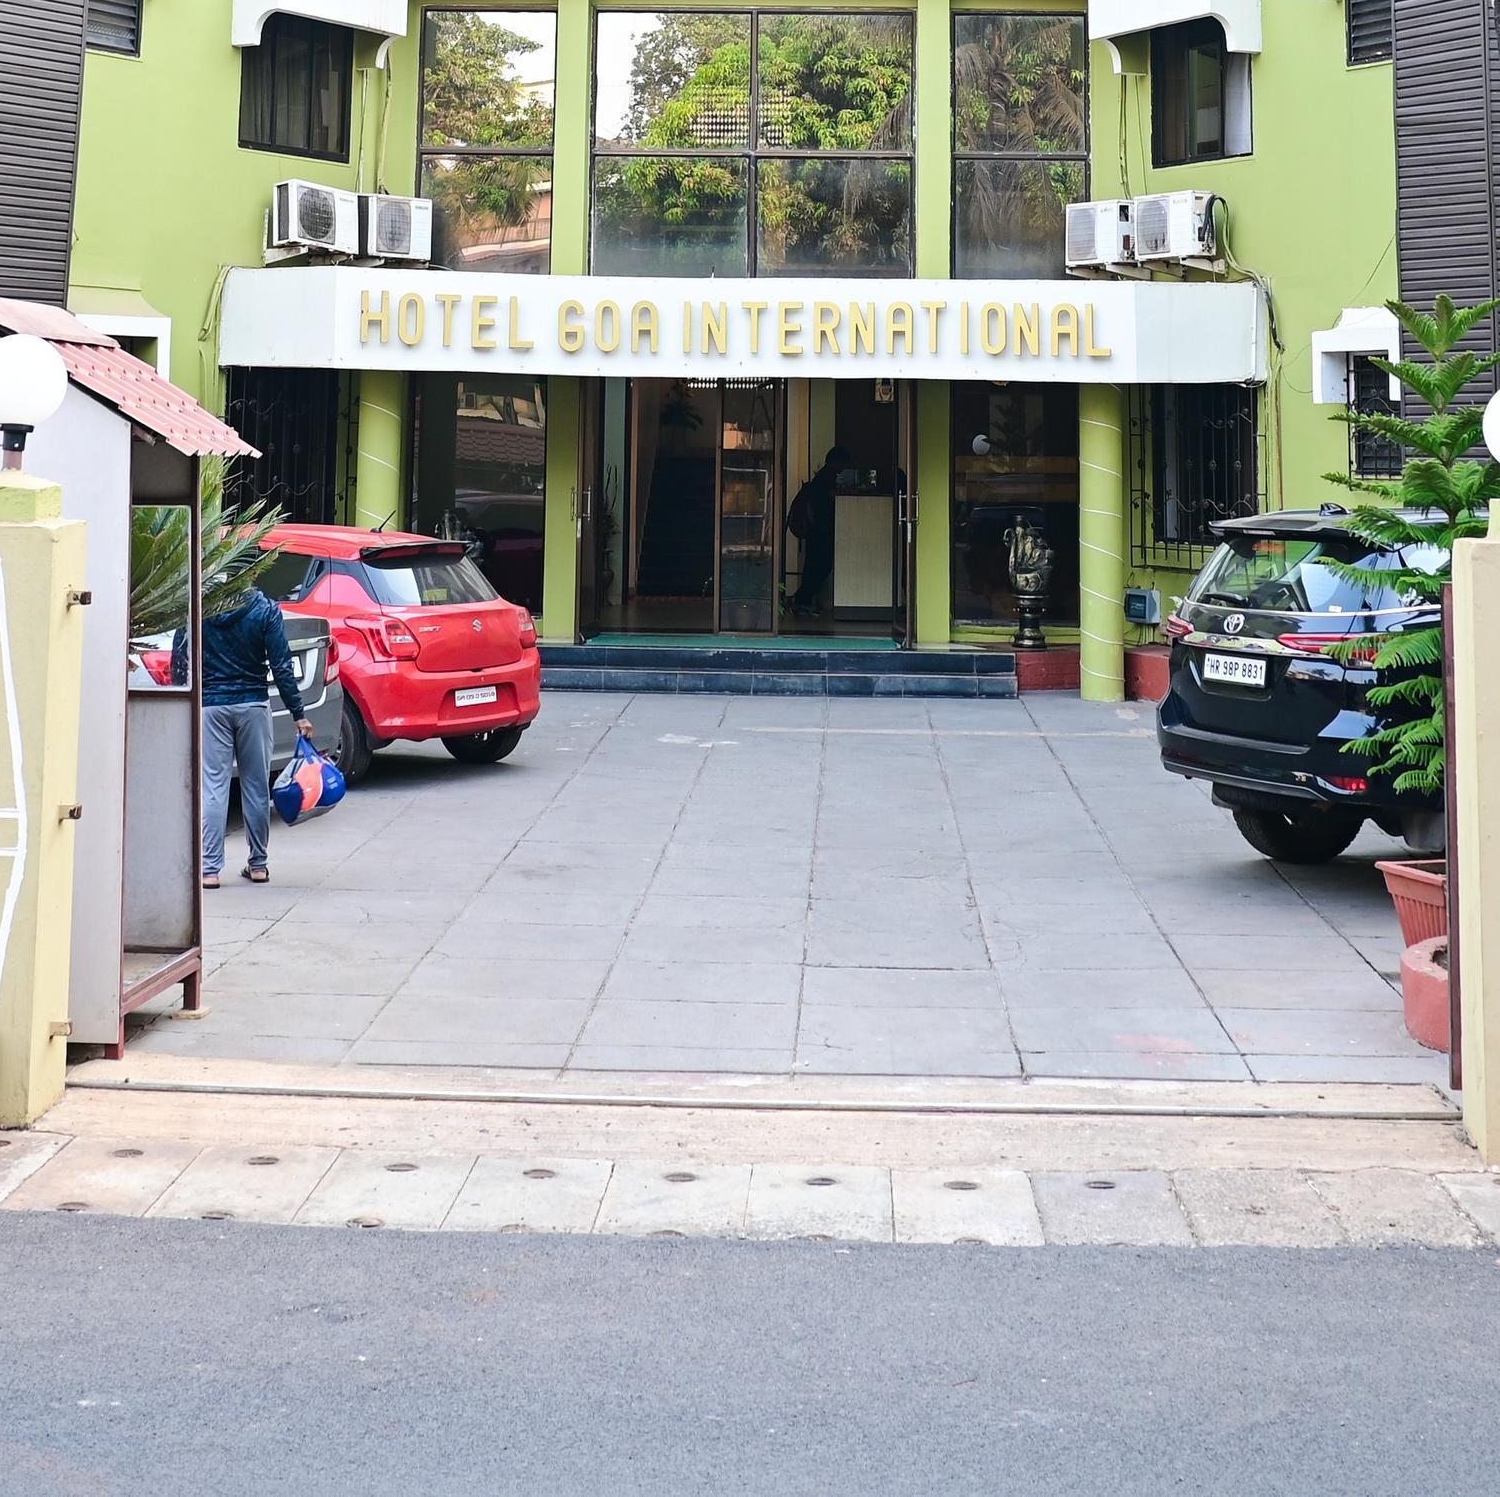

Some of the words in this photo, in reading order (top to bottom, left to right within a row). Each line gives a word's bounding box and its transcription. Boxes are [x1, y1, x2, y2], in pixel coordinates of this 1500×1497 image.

[360, 289, 534, 350] HOTEL
[557, 299, 660, 354] GOA
[683, 300, 1112, 357] INTERNATIONAL
[1210, 658, 1221, 675] HR
[1222, 660, 1240, 678] 98P
[1241, 663, 1263, 681] 8831
